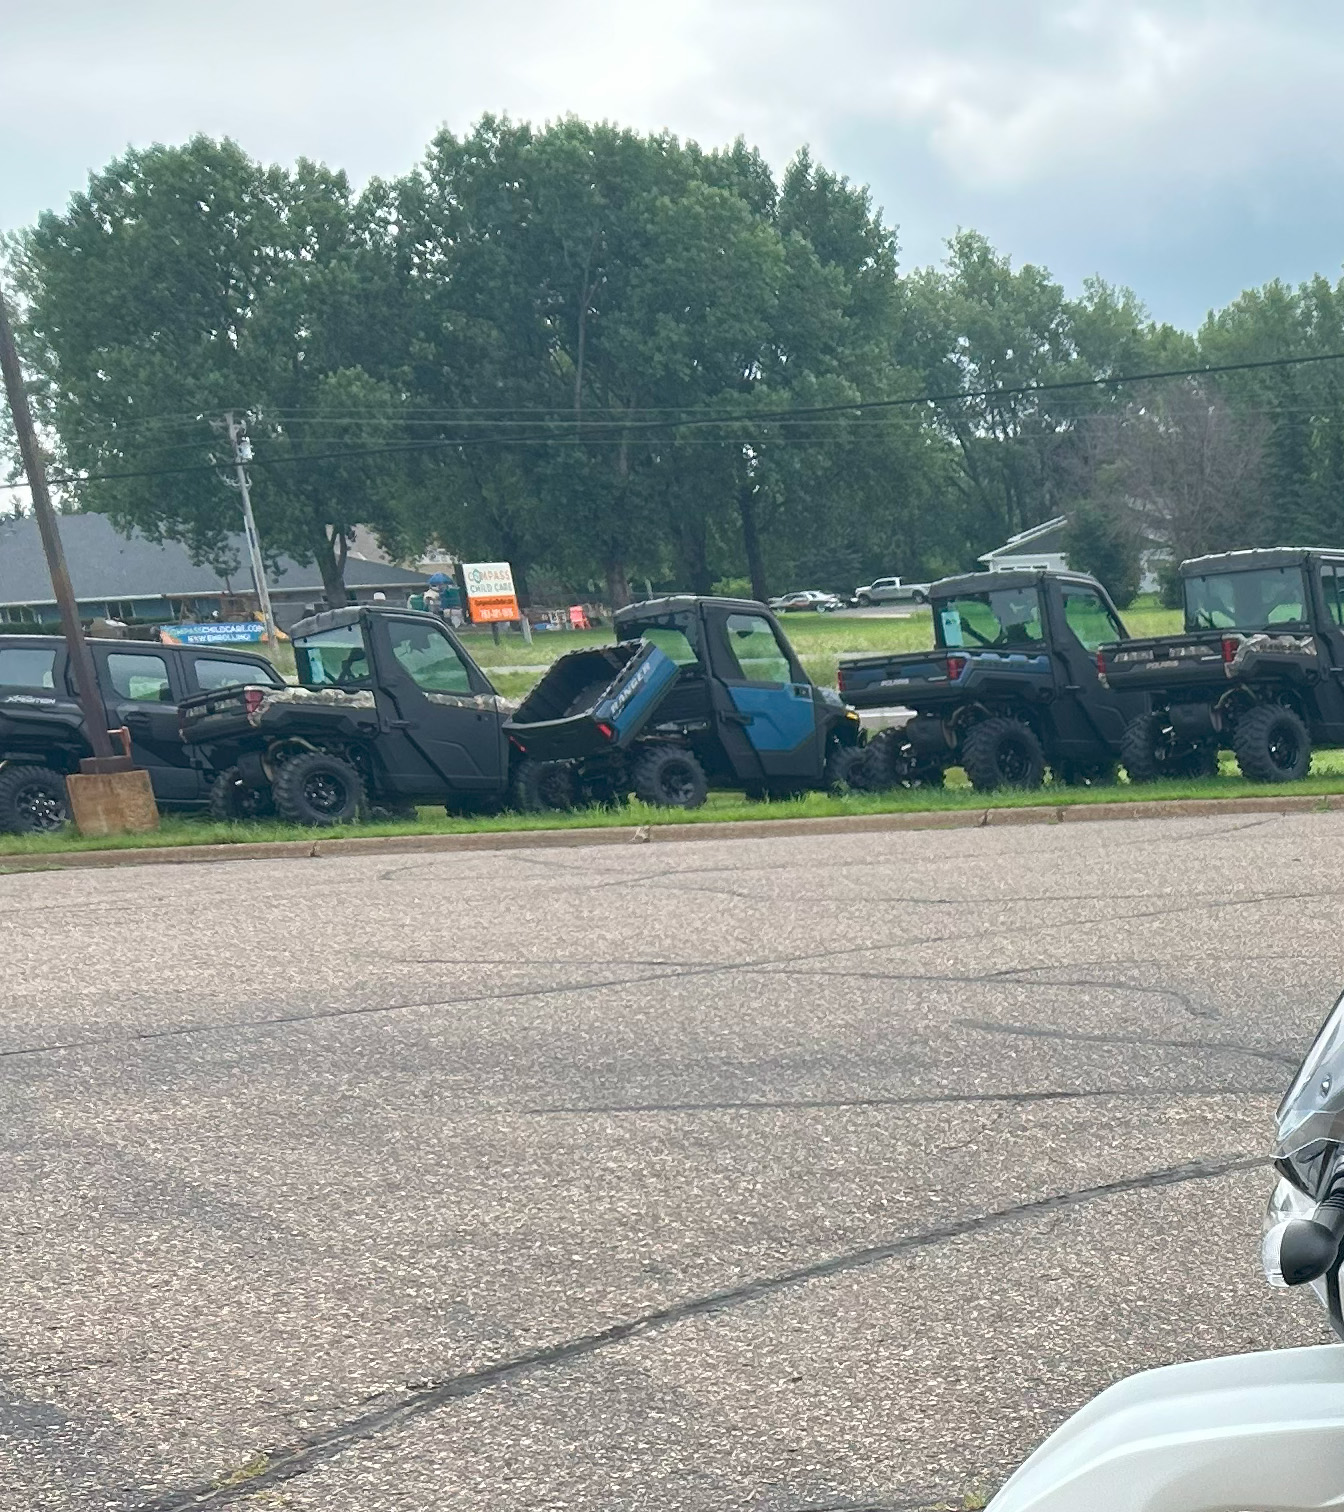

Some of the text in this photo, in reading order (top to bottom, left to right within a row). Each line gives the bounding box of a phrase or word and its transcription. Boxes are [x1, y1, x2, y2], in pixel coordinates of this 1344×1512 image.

[468, 569, 511, 583] COMPASS
[470, 582, 514, 593] CHILD CARE
[610, 662, 651, 714] RANGER
